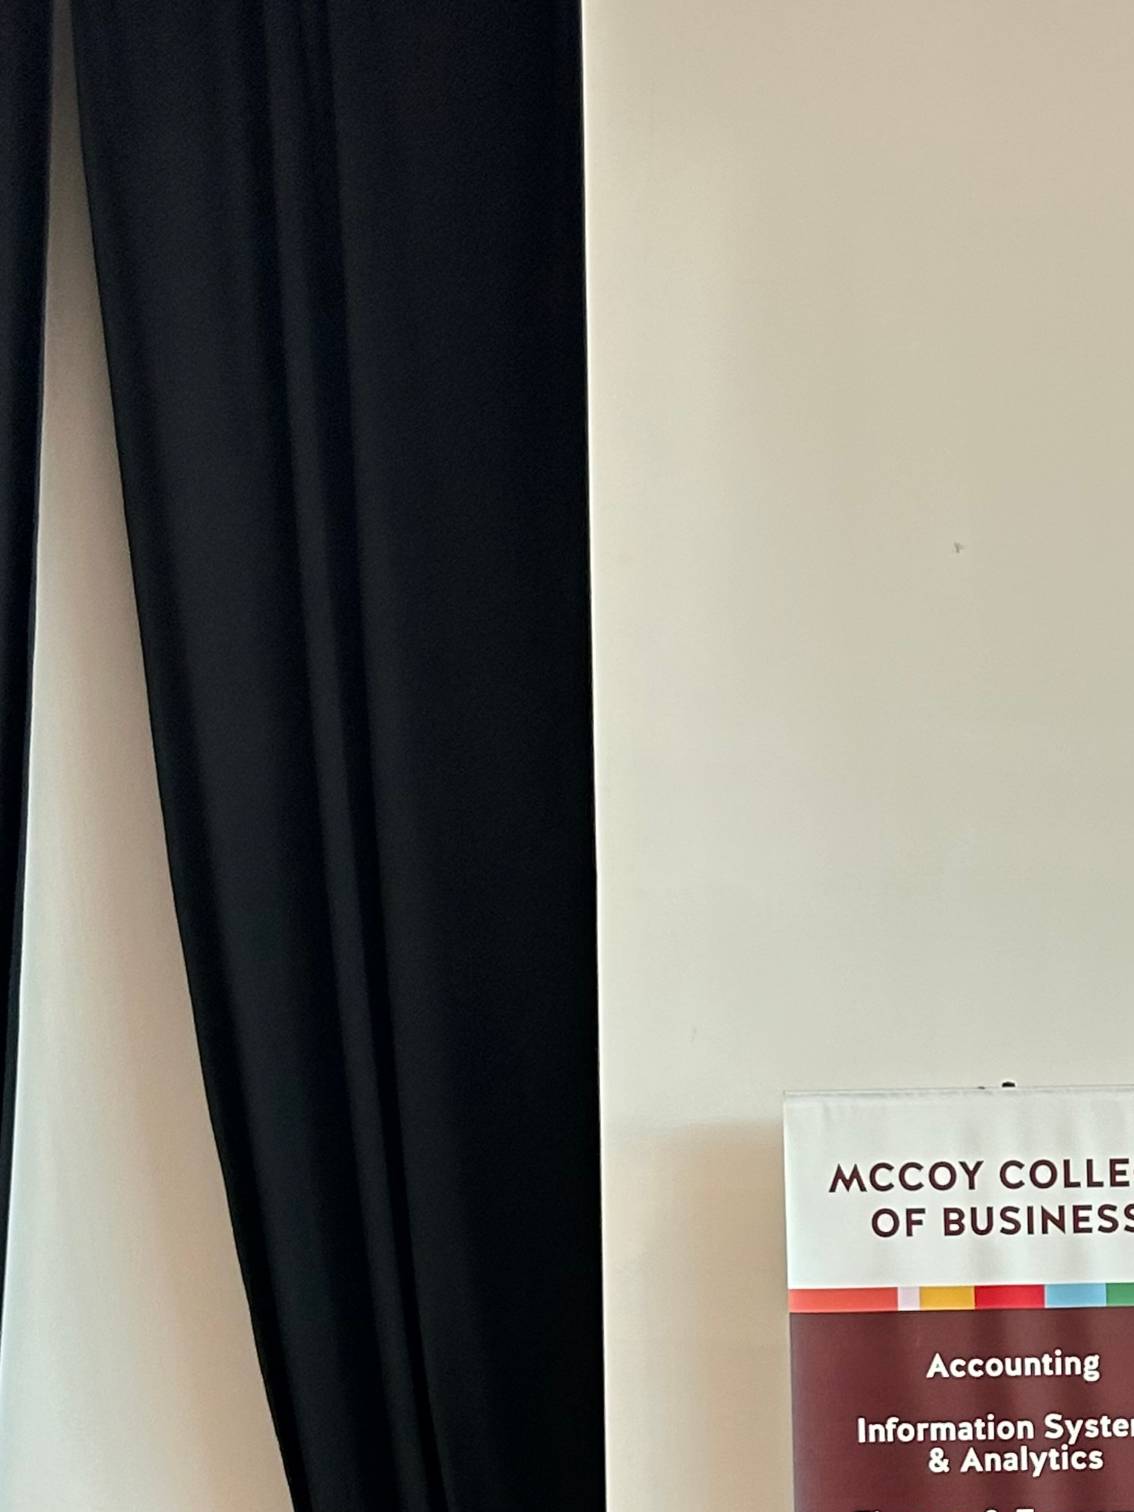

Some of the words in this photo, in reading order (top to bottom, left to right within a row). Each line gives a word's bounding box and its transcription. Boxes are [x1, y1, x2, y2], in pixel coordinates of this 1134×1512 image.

[829, 1160, 984, 1193] MCCOY
[871, 1207, 926, 1238] OF
[926, 1349, 1100, 1382] Accounting
[857, 1414, 1034, 1443] Information
[928, 1449, 950, 1473] &
[960, 1443, 1104, 1477] Analytics
